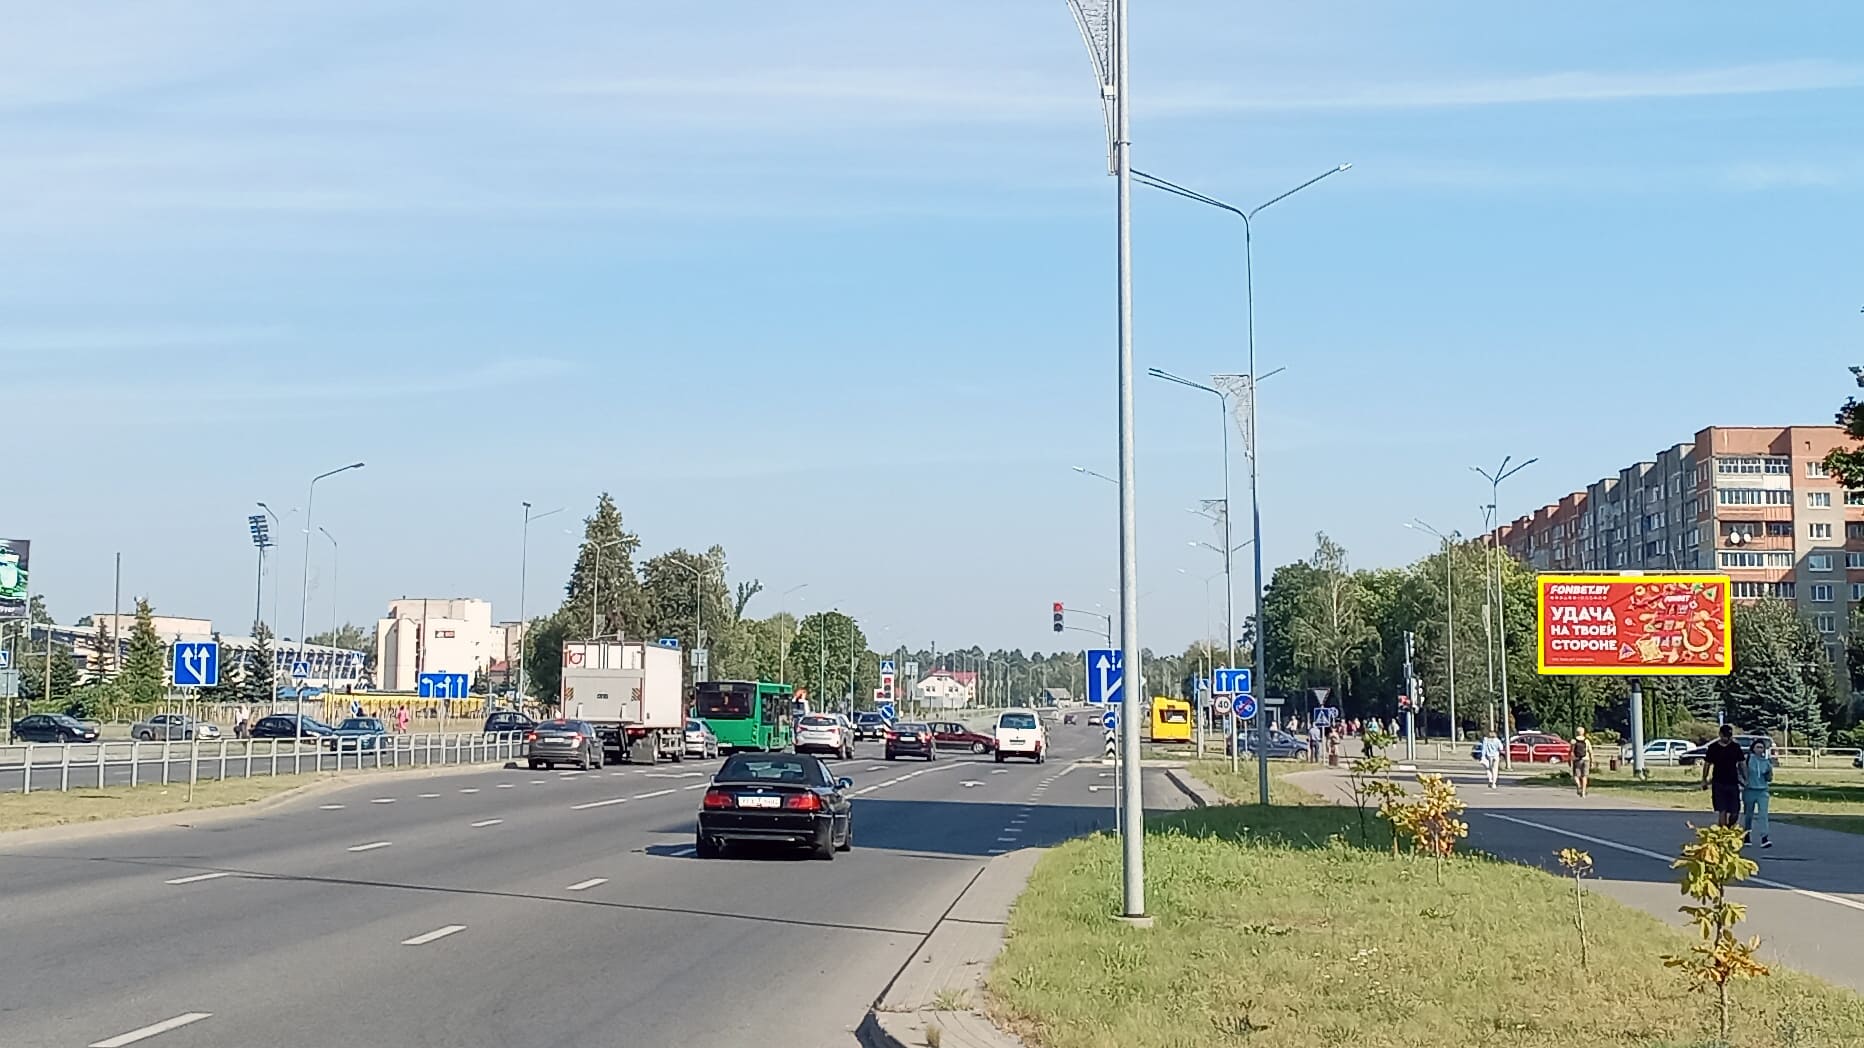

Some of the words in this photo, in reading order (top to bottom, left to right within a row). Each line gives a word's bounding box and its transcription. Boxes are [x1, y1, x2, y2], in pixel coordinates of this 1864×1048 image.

[1550, 606, 1616, 623] УДАЧА
[1550, 624, 1570, 636] НА
[1572, 622, 1617, 636] ТВОЕЙ
[1551, 639, 1618, 651] СТОРОНЕ
[1217, 700, 1230, 709] 40
